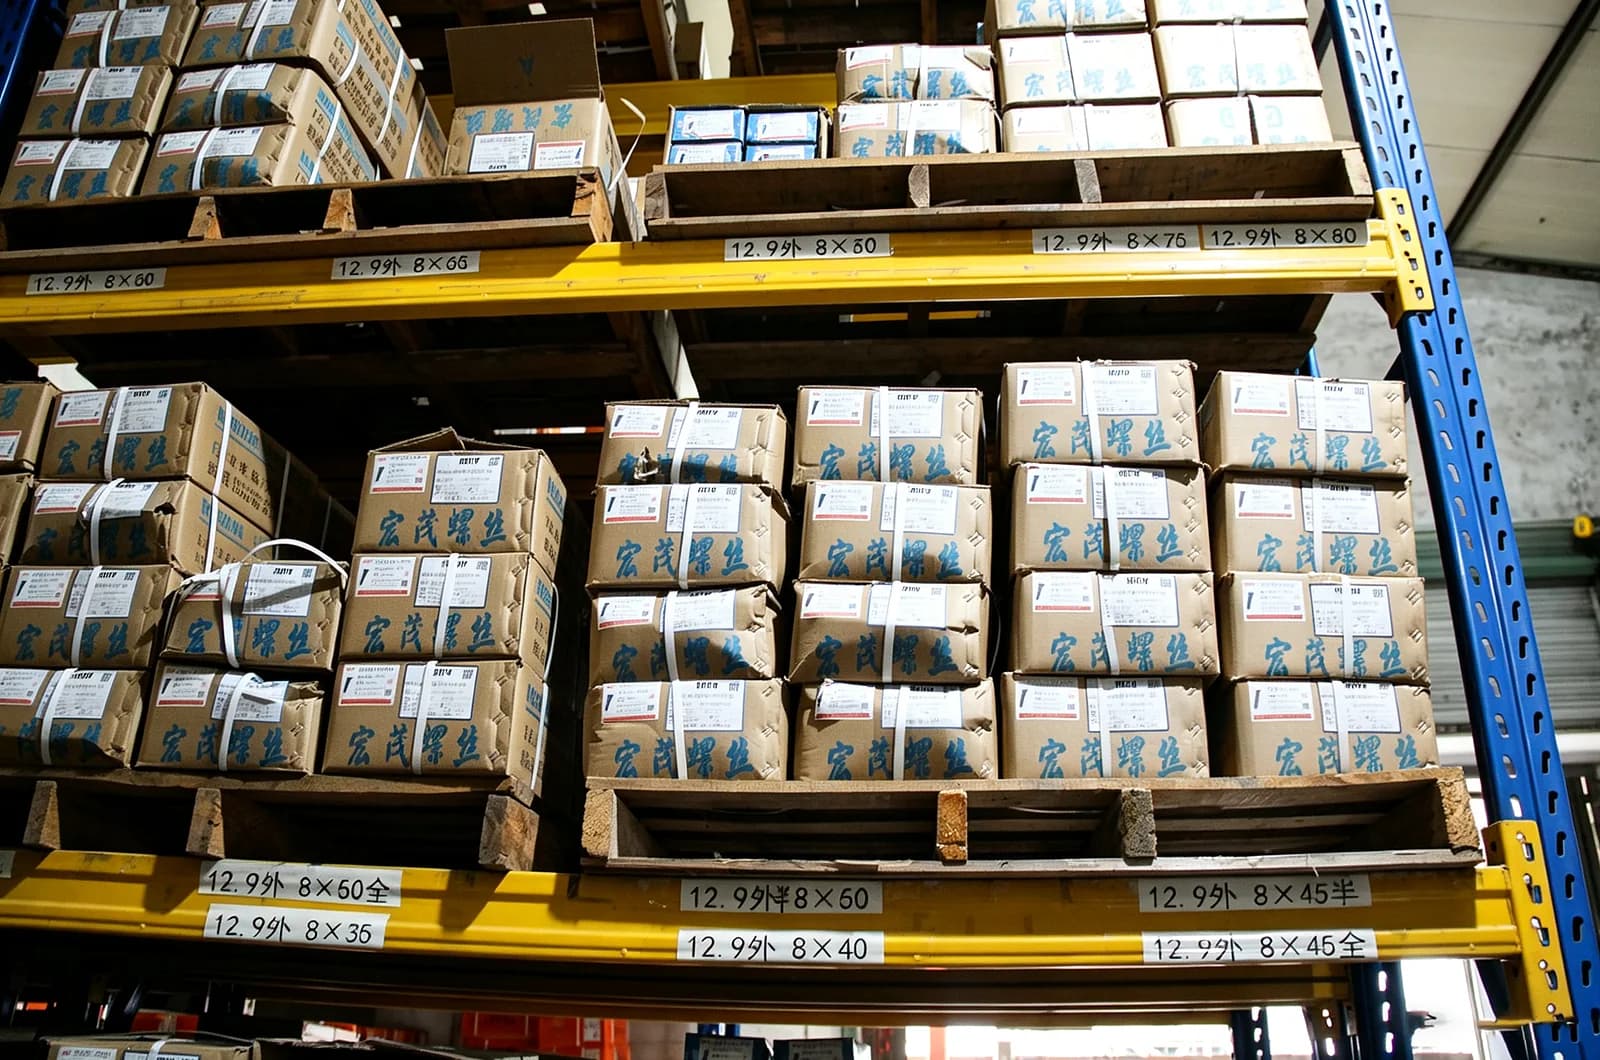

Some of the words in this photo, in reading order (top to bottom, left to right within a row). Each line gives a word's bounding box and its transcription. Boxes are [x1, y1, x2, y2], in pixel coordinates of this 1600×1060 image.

[1032, 418, 1172, 459] 宏茂螺丝
[1250, 432, 1388, 473] 宏茂螺丝
[819, 441, 951, 482] 宏茂螺丝
[379, 507, 506, 548] 宏茂螺丝
[1043, 521, 1184, 564] 宏茂螺丝
[616, 536, 749, 579] 宏茂螺丝
[827, 536, 963, 579] 宏茂螺丝
[1256, 533, 1399, 576] 宏茂螺丝
[15, 621, 129, 661] 宏茂螺丝
[816, 632, 958, 678] 宏茂螺丝
[1264, 637, 1407, 677] 宏茂螺丝
[160, 723, 287, 767] 宏茂螺丝
[348, 723, 481, 768] 宏茂螺丝
[613, 735, 755, 779] 宏茂螺丝
[827, 735, 973, 780] 宏茂螺丝
[1038, 735, 1187, 779] 宏茂螺丝
[1274, 734, 1421, 777] 宏茂螺丝
